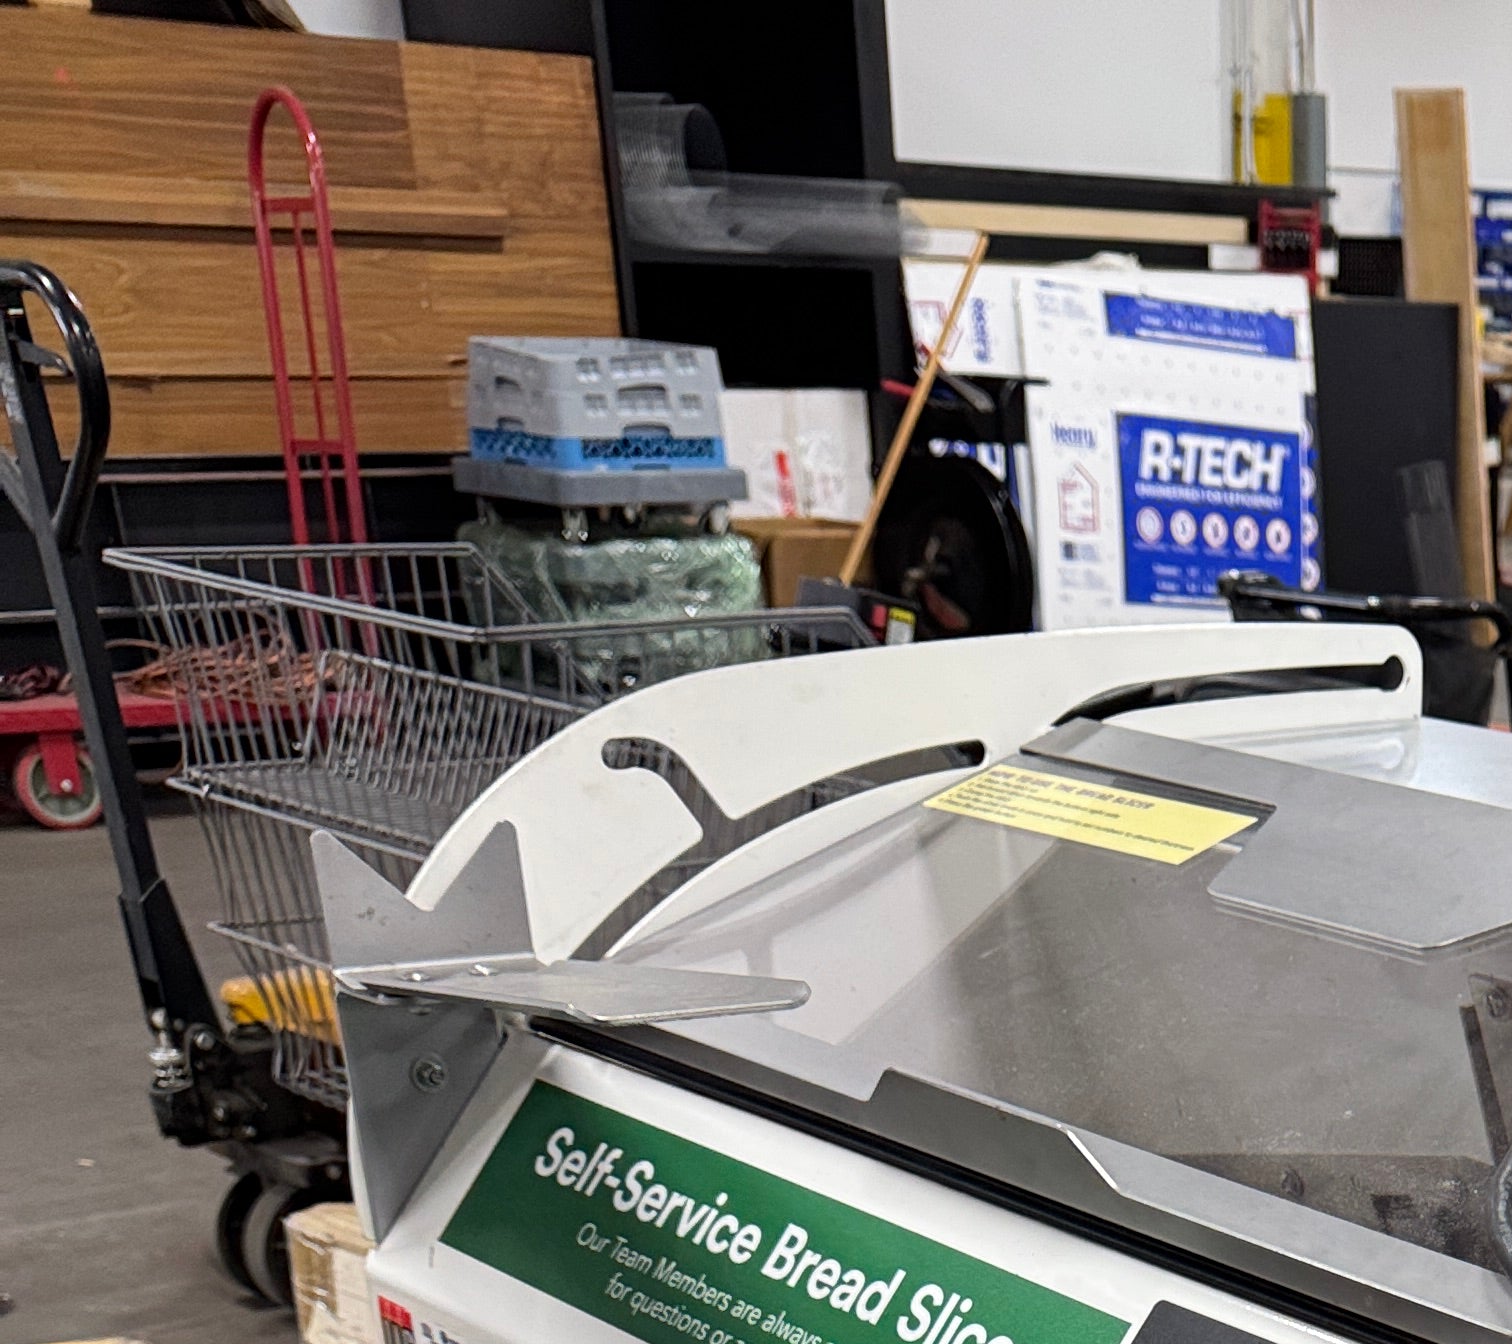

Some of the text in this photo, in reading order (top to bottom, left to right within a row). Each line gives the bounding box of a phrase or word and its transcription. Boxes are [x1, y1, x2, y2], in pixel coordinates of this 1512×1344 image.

[534, 1128, 761, 1263] Self-Service
[761, 1223, 905, 1324] Bread
[576, 1222, 611, 1252] Our
[610, 1235, 653, 1276] Team
[652, 1257, 732, 1311] Members
[729, 1299, 762, 1326] are
[604, 1271, 633, 1301] for
[629, 1291, 710, 1340] questions
